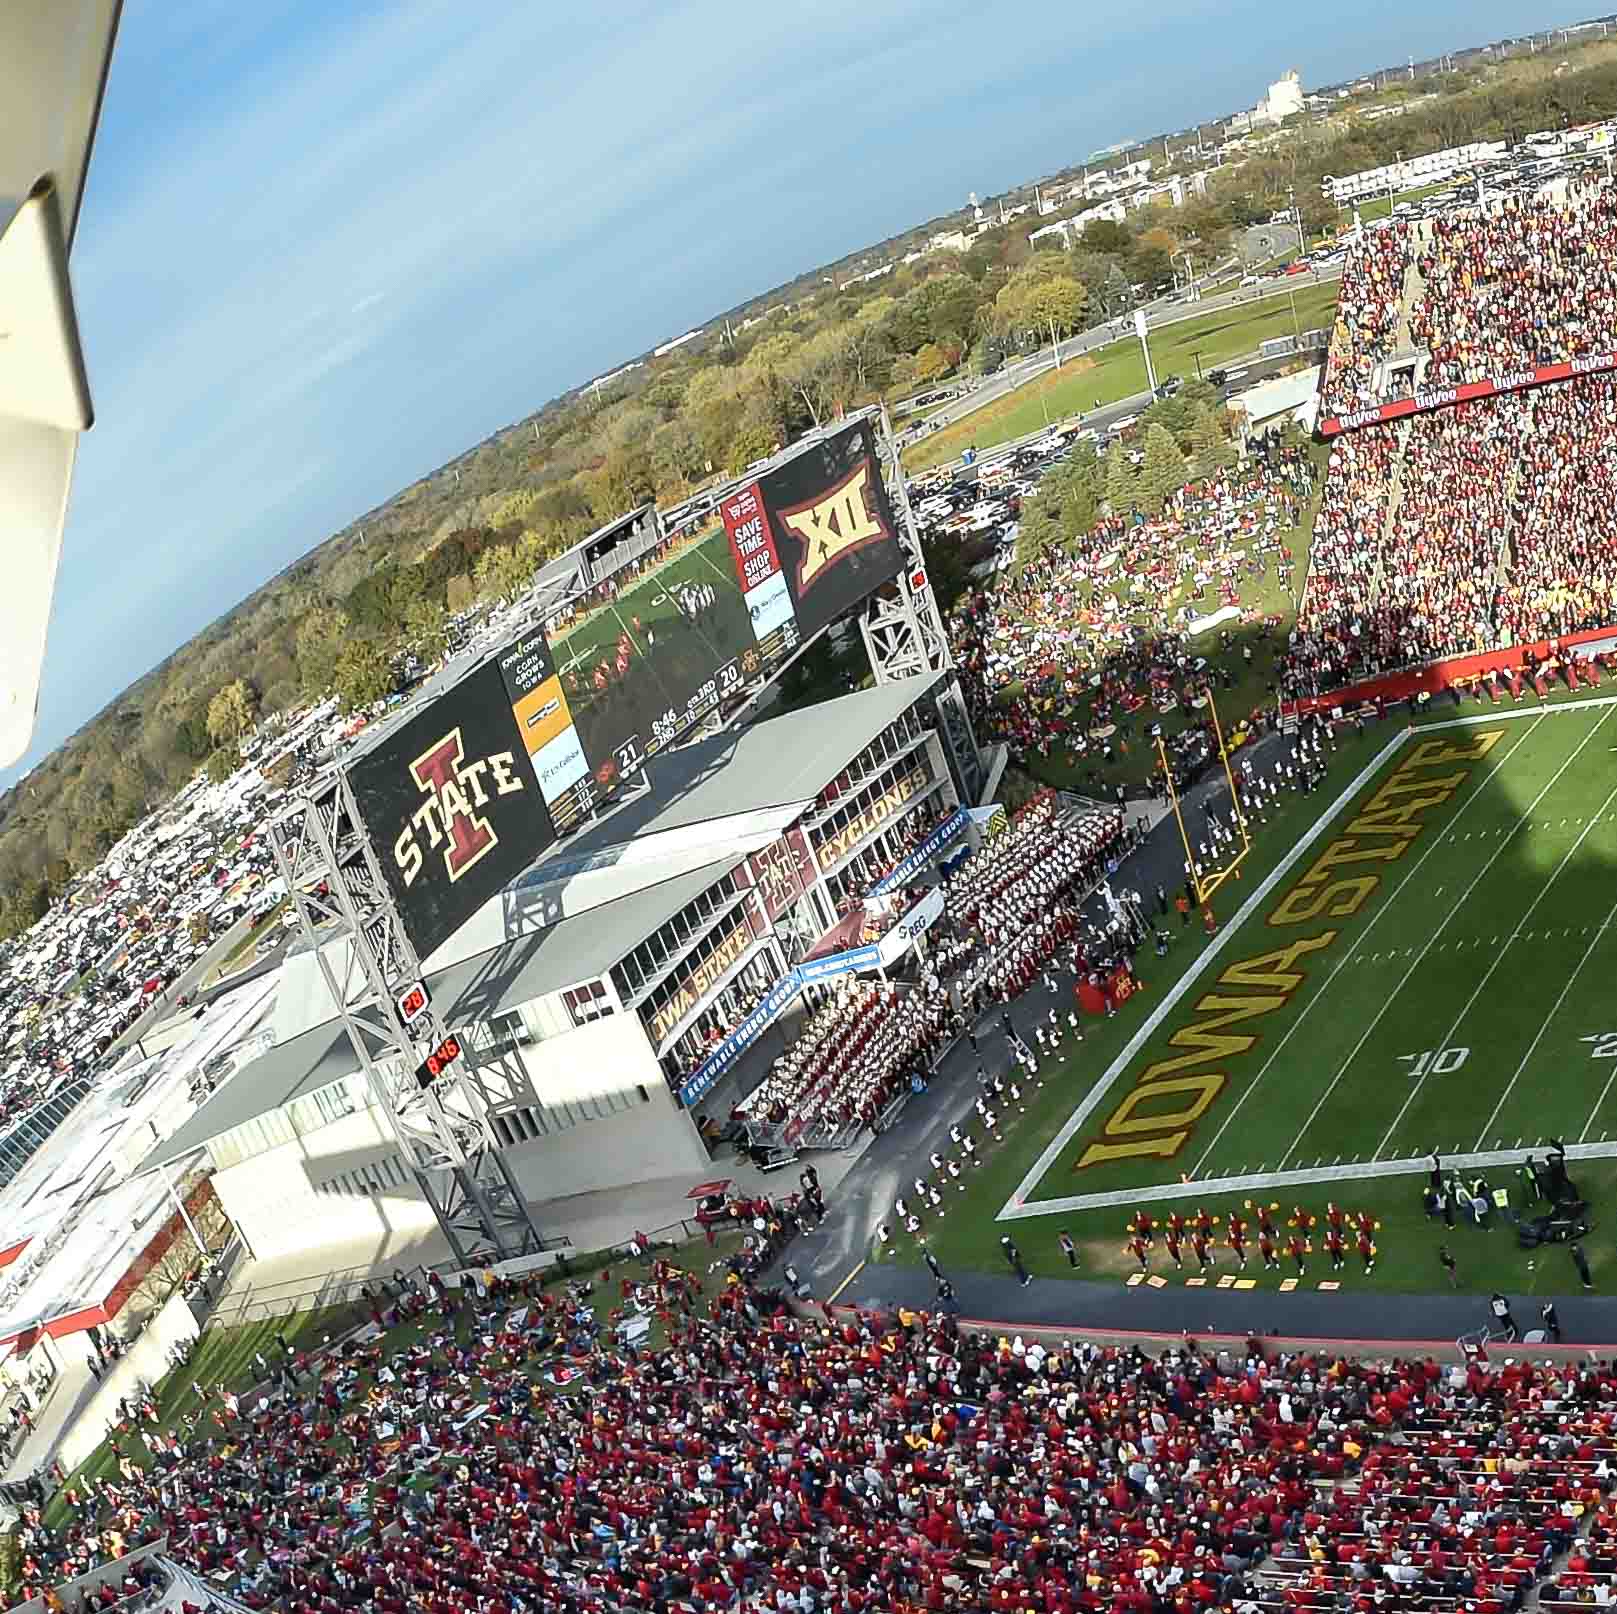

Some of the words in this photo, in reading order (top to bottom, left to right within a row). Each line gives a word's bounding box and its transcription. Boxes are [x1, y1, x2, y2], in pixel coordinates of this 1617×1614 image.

[735, 516, 763, 544] SAVE
[782, 463, 884, 588] XII
[738, 533, 766, 557] TIME.
[743, 550, 770, 577] SHOP
[720, 665, 738, 688] 20
[651, 708, 677, 735] 8:46
[619, 743, 637, 767] 21
[394, 751, 524, 888] STATE
[818, 767, 930, 869] CYCLONES
[913, 837, 940, 866] ENERGY
[909, 915, 926, 938] REG
[694, 926, 749, 995] STATE
[1075, 929, 1338, 1168] IOWA
[1266, 730, 1507, 928] STATE
[687, 1043, 736, 1098] RENEWABLE
[735, 1006, 768, 1045] ENERGY
[1407, 1047, 1470, 1077] 10
